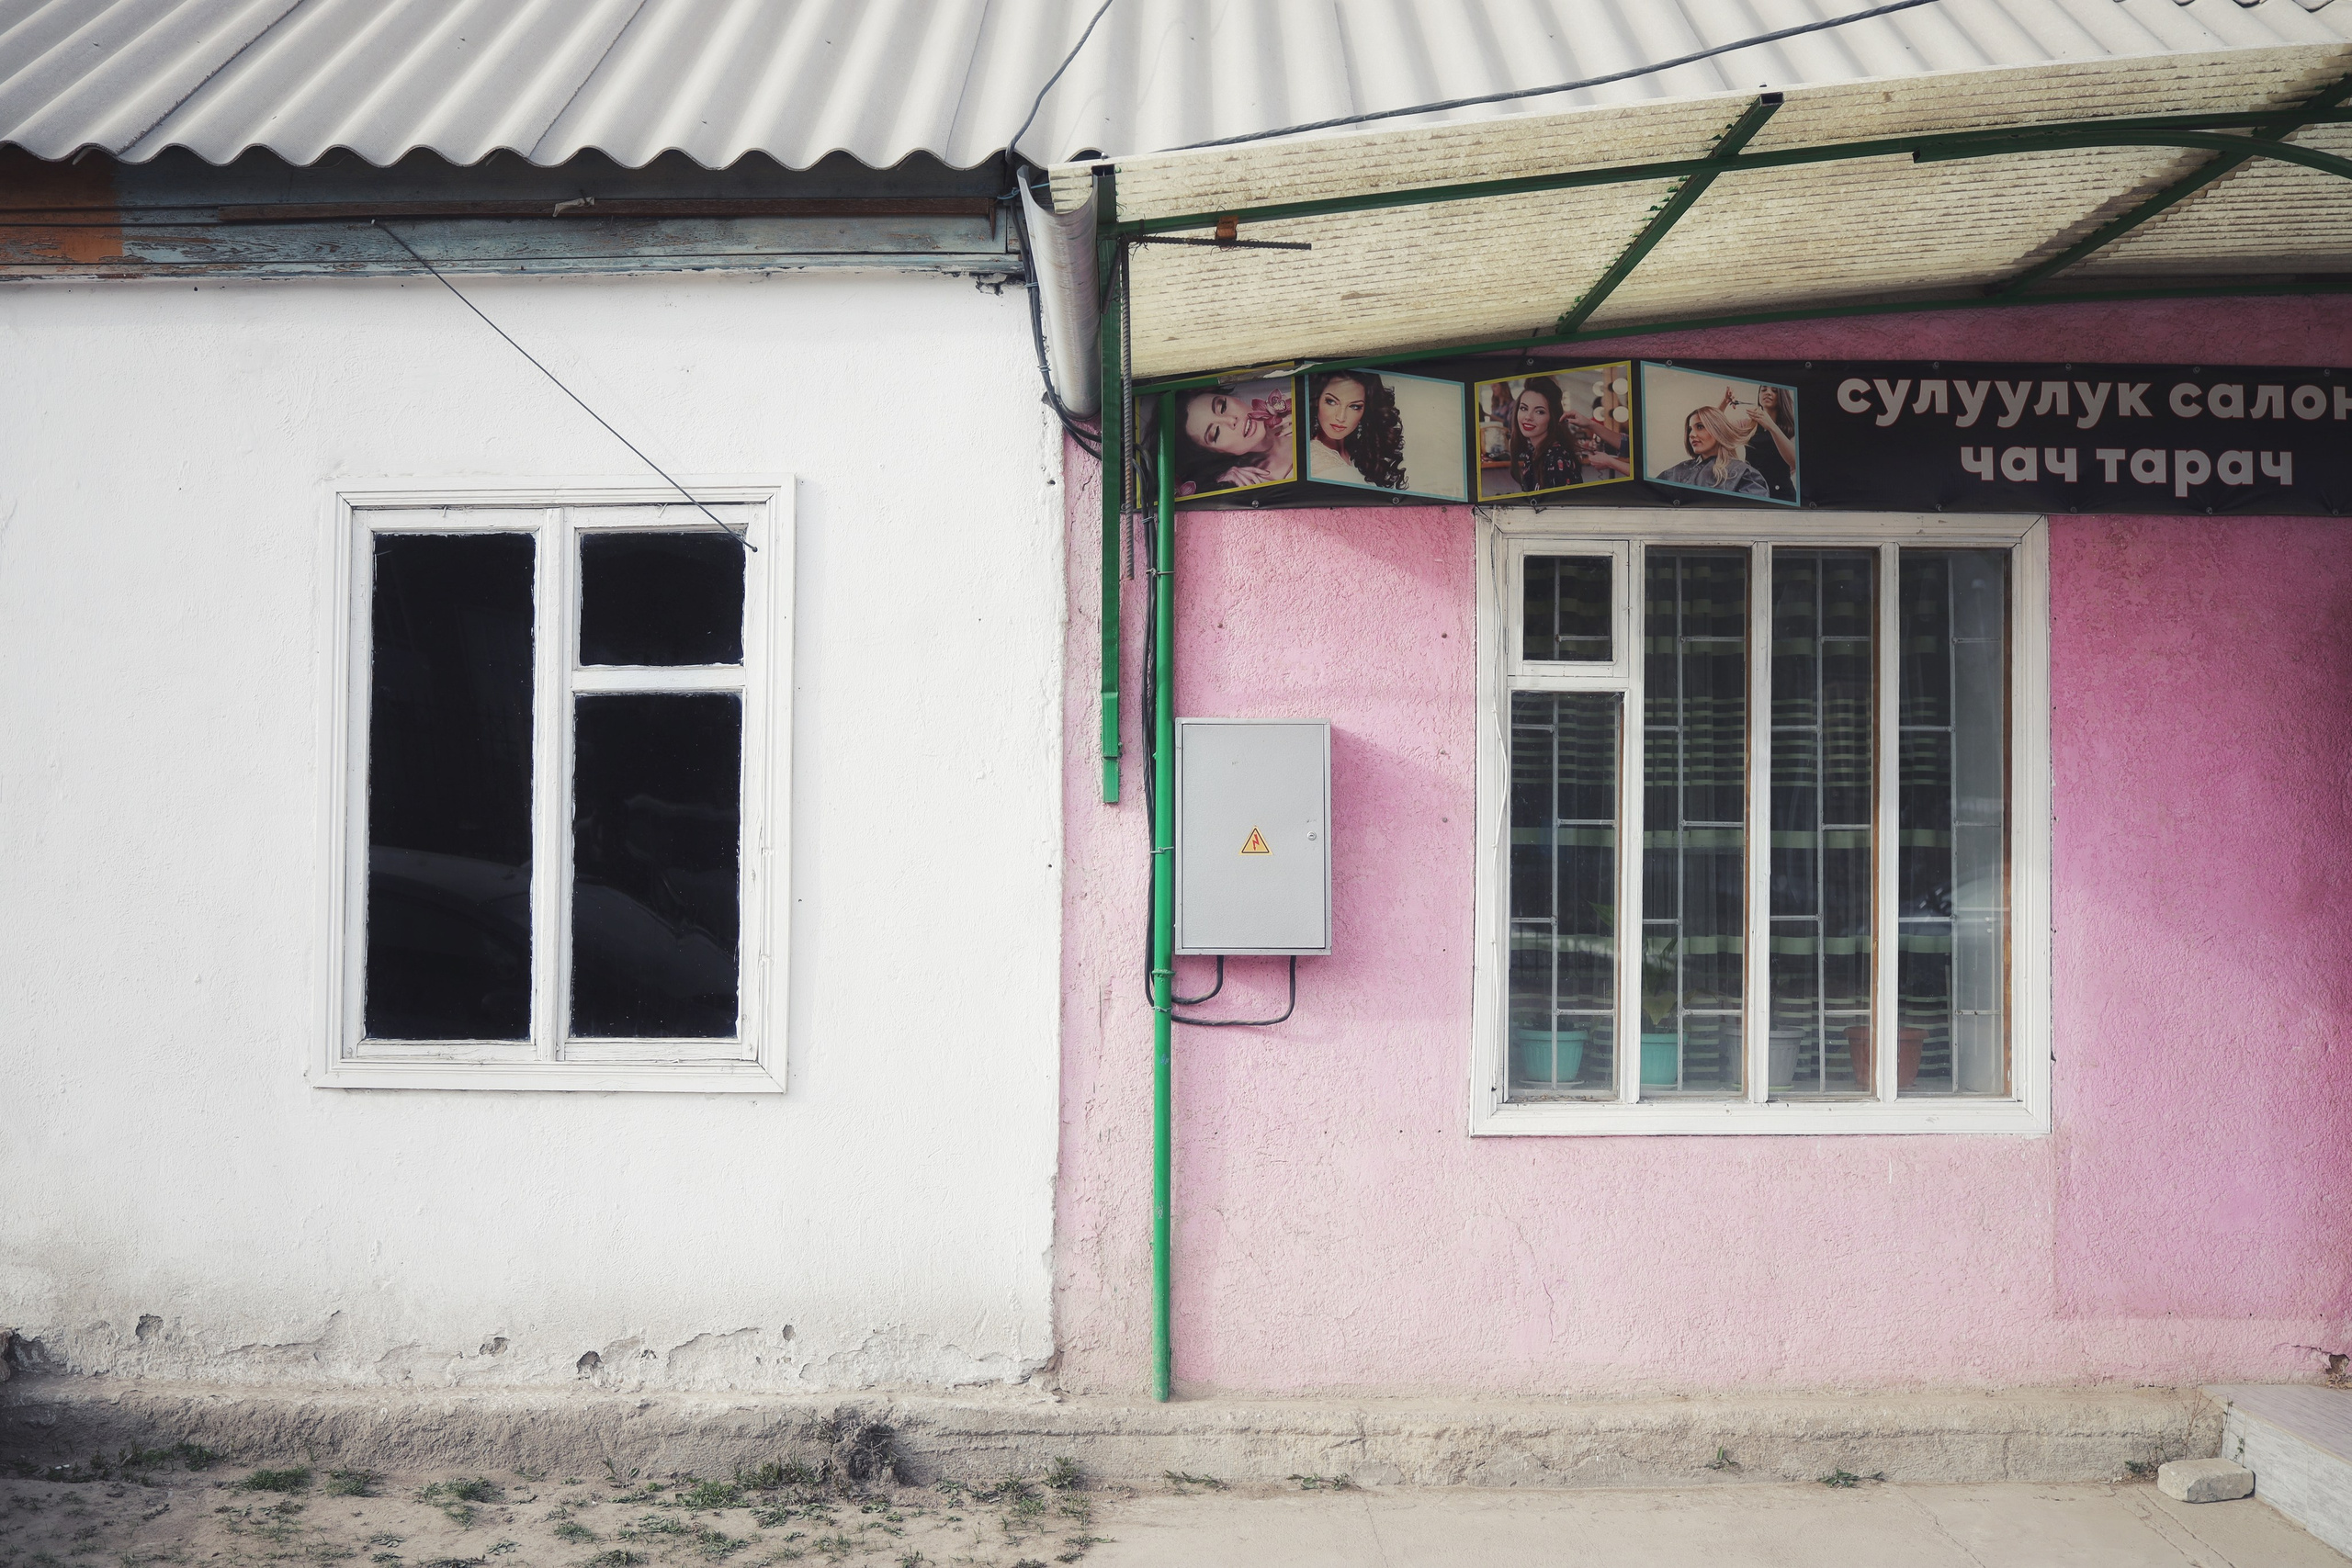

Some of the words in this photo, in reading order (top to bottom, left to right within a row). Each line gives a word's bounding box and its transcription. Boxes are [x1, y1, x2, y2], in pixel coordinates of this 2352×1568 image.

[1837, 378, 2153, 429] сулуулук
[1960, 446, 2077, 483] чач
[2096, 448, 2293, 498] тарач
